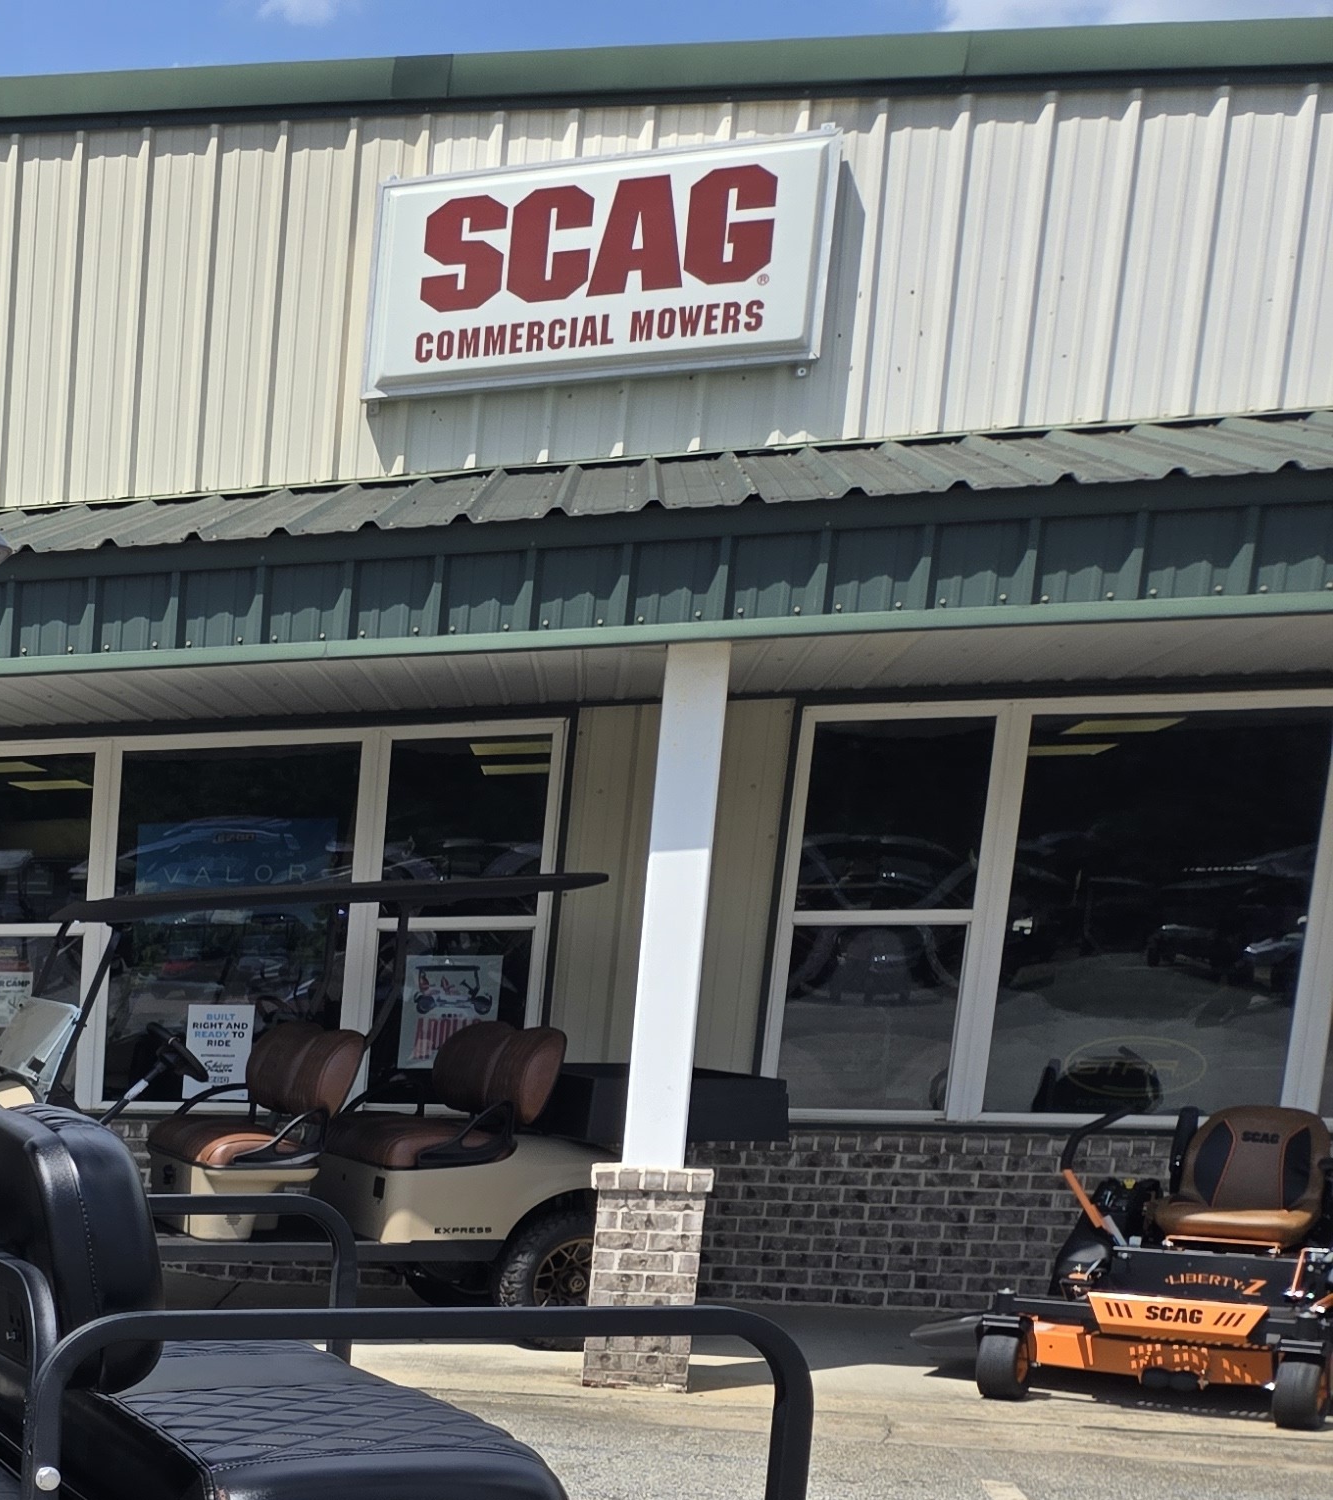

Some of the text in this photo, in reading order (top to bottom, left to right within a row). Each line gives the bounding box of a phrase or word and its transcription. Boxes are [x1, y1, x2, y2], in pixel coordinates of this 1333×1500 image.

[420, 164, 779, 312] SCAG
[415, 300, 765, 363] COMMERCIAL MOWERS
[163, 864, 307, 883] VALOR
[206, 1013, 236, 1021] BUILT
[193, 1022, 249, 1030] RIGHT AND
[231, 1031, 245, 1039] TO
[1241, 1130, 1280, 1144] SCAG
[434, 1226, 492, 1234] EXPRESS
[1169, 1273, 1267, 1296] LIBERTY Z
[1145, 1305, 1203, 1324] SCAG
